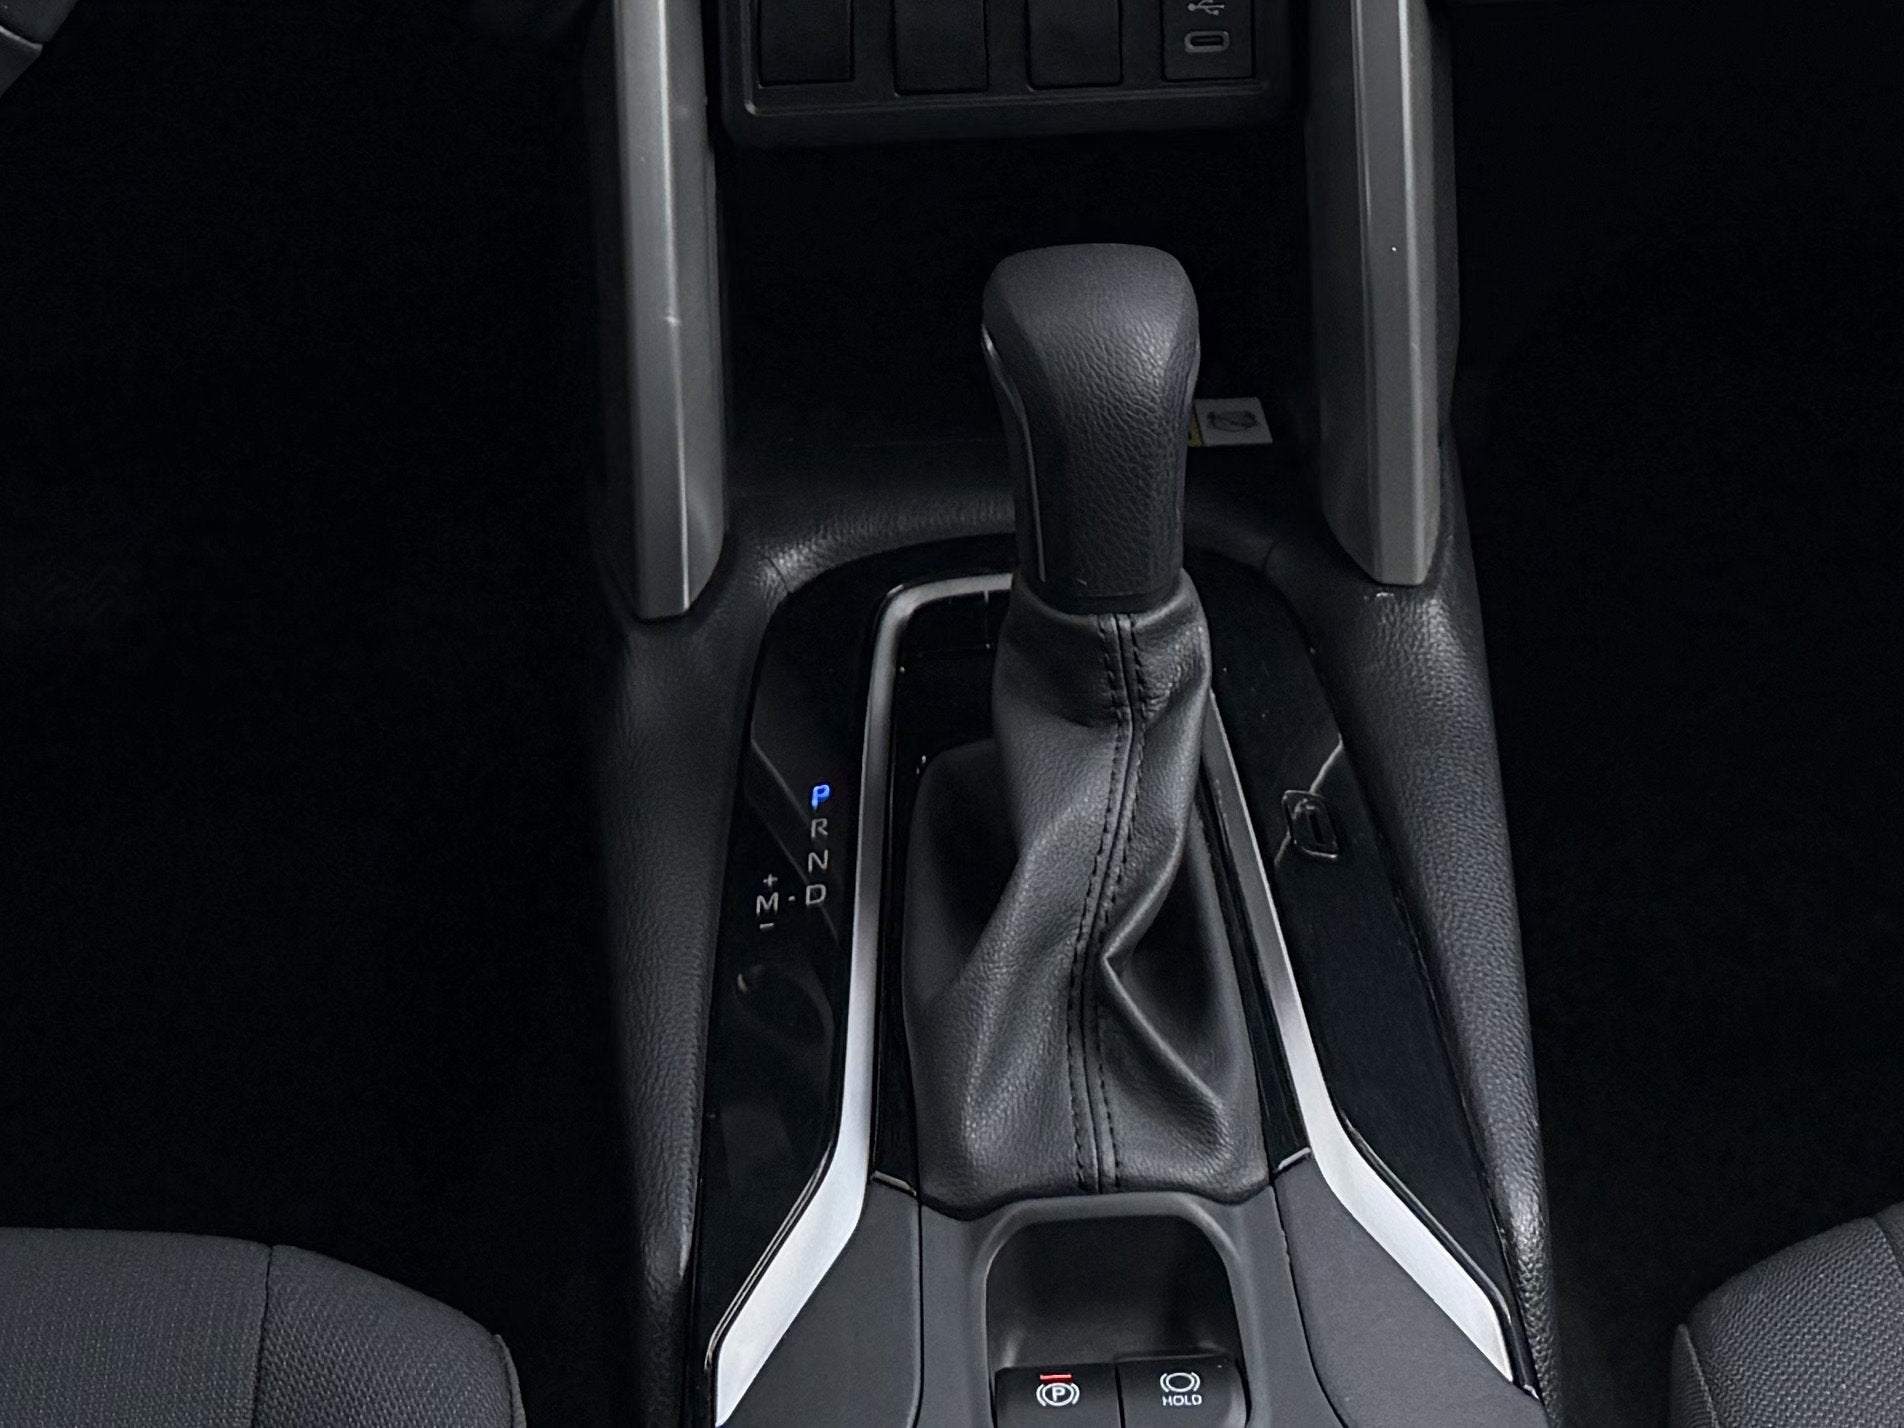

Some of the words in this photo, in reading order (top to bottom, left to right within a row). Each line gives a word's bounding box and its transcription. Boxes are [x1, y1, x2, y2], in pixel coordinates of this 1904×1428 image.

[811, 784, 830, 809] P
[811, 818, 828, 838] R
[808, 849, 828, 873] N
[756, 892, 779, 916] M
[805, 884, 826, 905] D
[1162, 1394, 1202, 1406] HOLD
